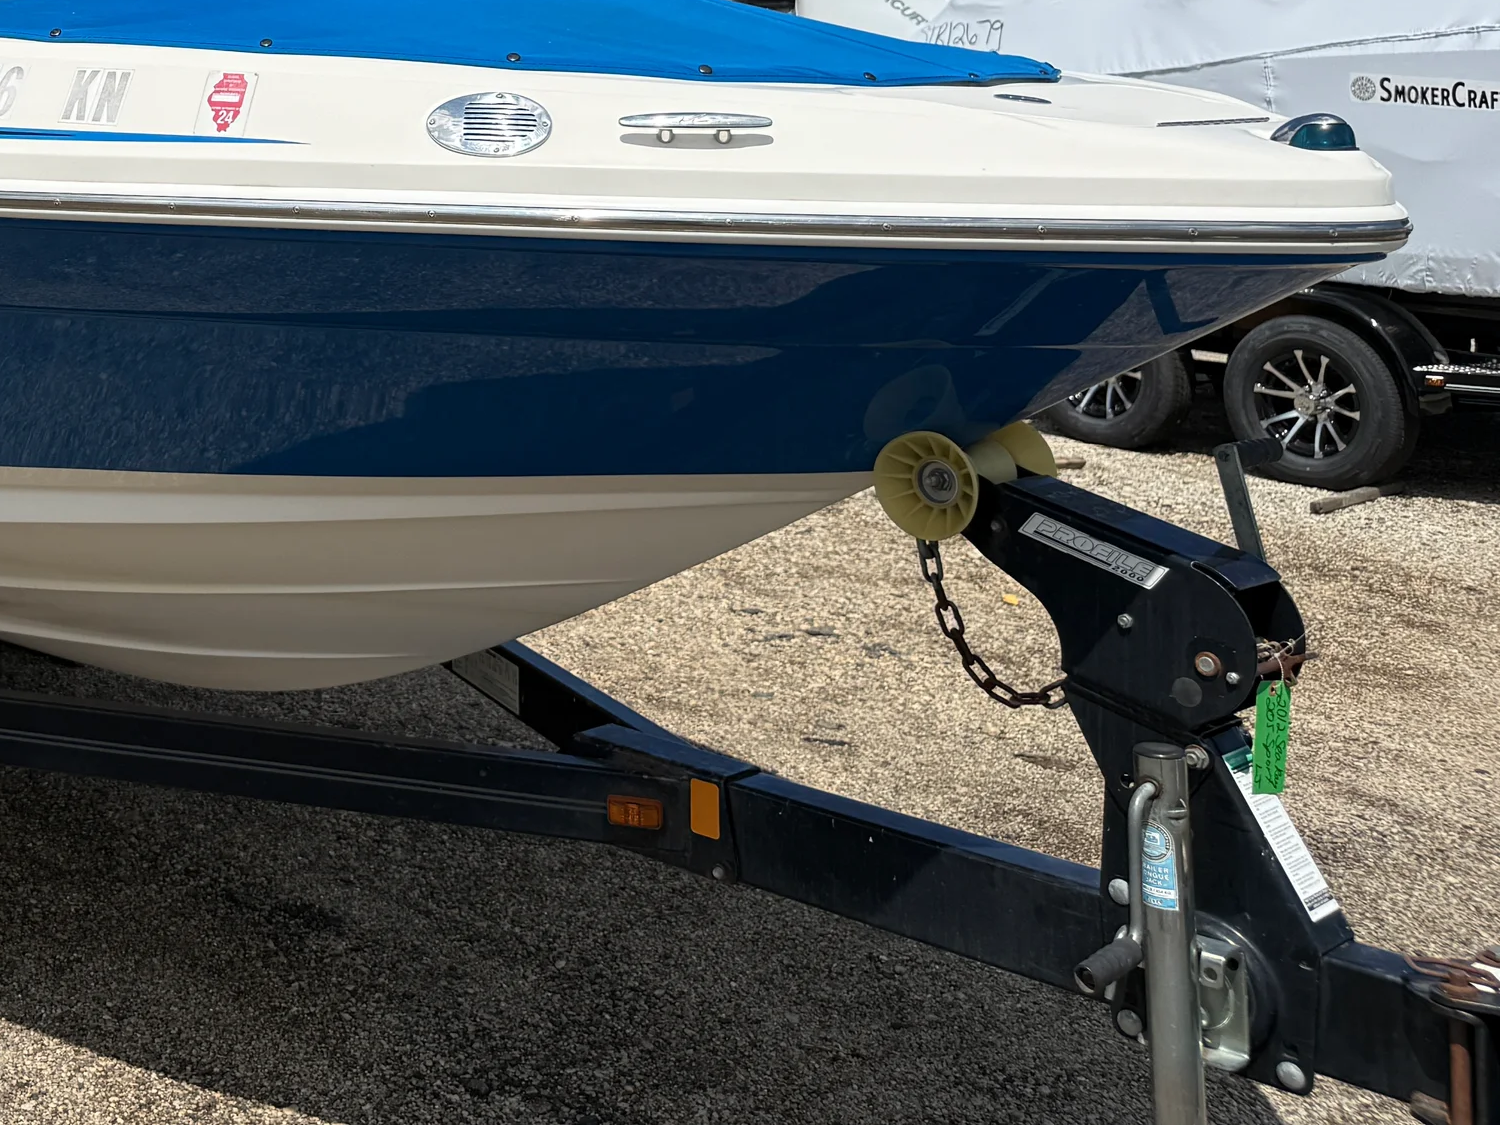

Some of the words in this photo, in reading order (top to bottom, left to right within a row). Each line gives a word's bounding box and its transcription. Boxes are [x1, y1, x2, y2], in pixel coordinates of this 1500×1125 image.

[60, 69, 132, 123] KN
[1379, 77, 1500, 109] SMOKERCRAF
[217, 110, 234, 124] 24
[1036, 518, 1155, 578] PROFILE
[1111, 565, 1144, 582] 2000
[1266, 697, 1276, 733] 205
[1276, 690, 1287, 733] 2012
[1275, 734, 1286, 763] Sea
